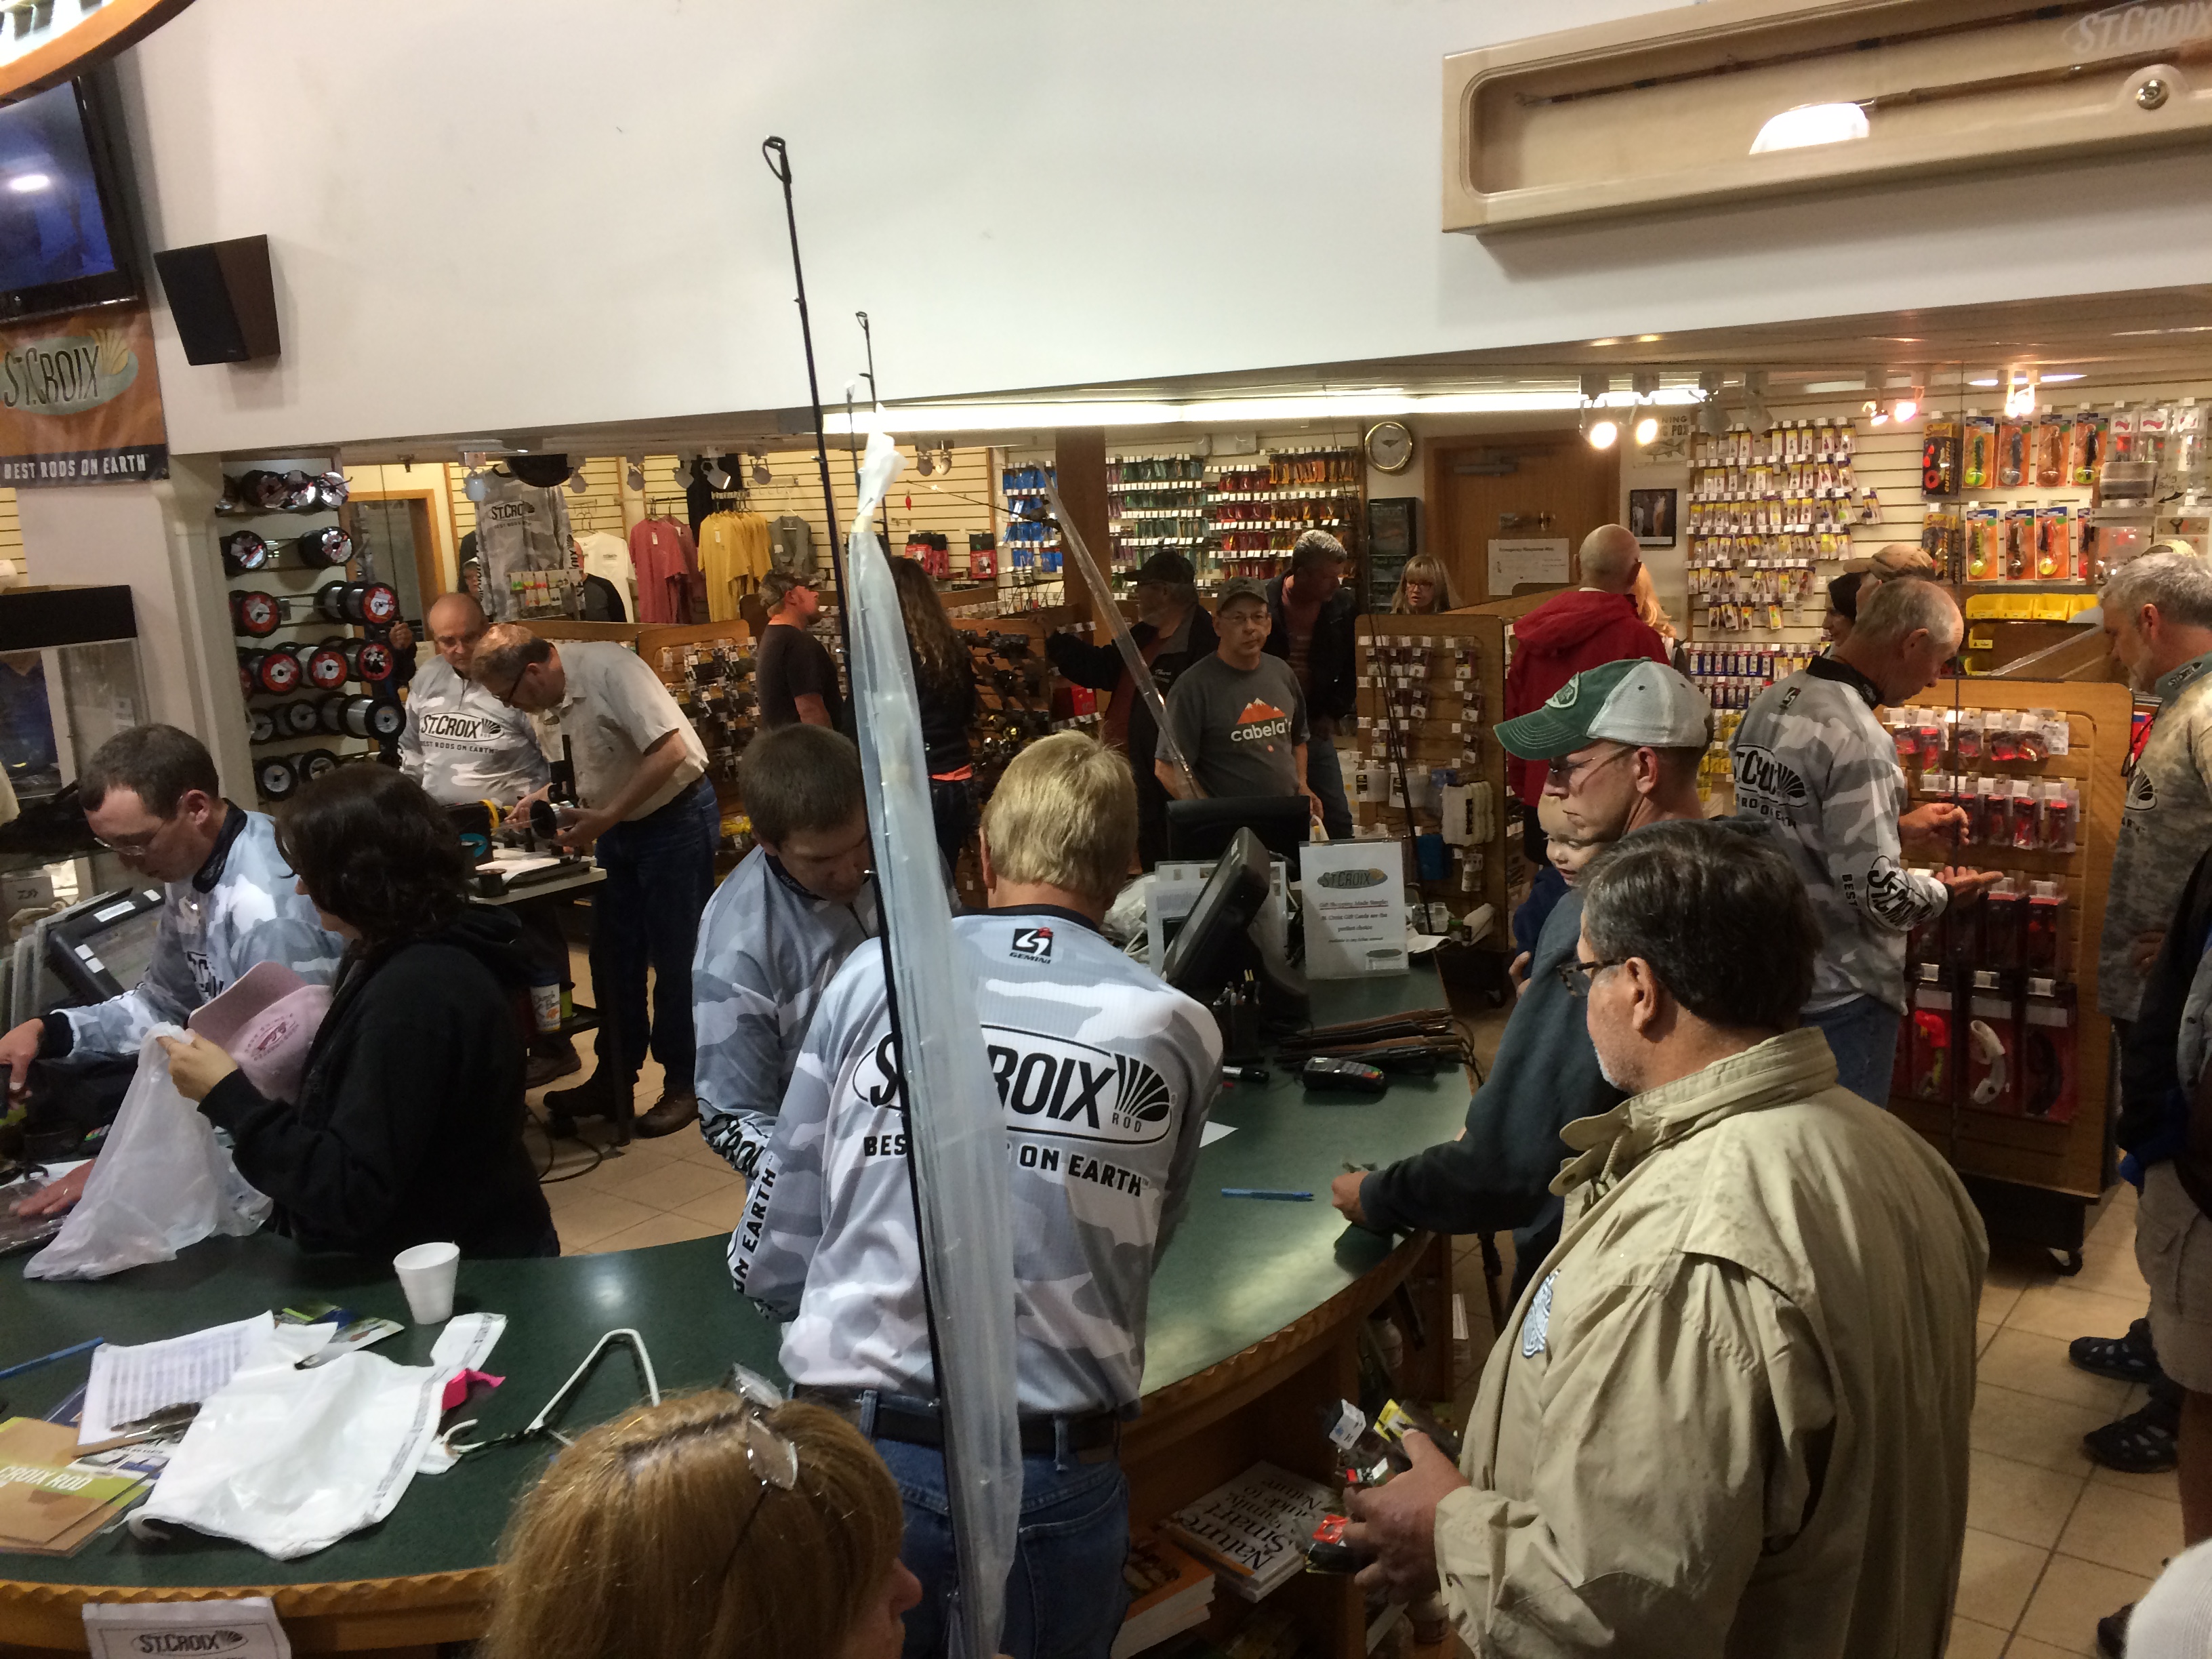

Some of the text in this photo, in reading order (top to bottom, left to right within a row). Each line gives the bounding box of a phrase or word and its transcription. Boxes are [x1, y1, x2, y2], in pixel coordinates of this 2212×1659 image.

[1662, 415, 1687, 424] NING
[4, 454, 147, 480] BEST RODS ON EARTH
[491, 504, 524, 520] ST.CRO
[421, 714, 482, 739] ST.CROIX
[1009, 951, 1052, 964] GEMINI
[1112, 1112, 1142, 1133] ROD
[863, 1133, 1143, 1197] BES ON EARTH
[742, 1169, 777, 1254] EARTH
[44, 1473, 94, 1491] ROD
